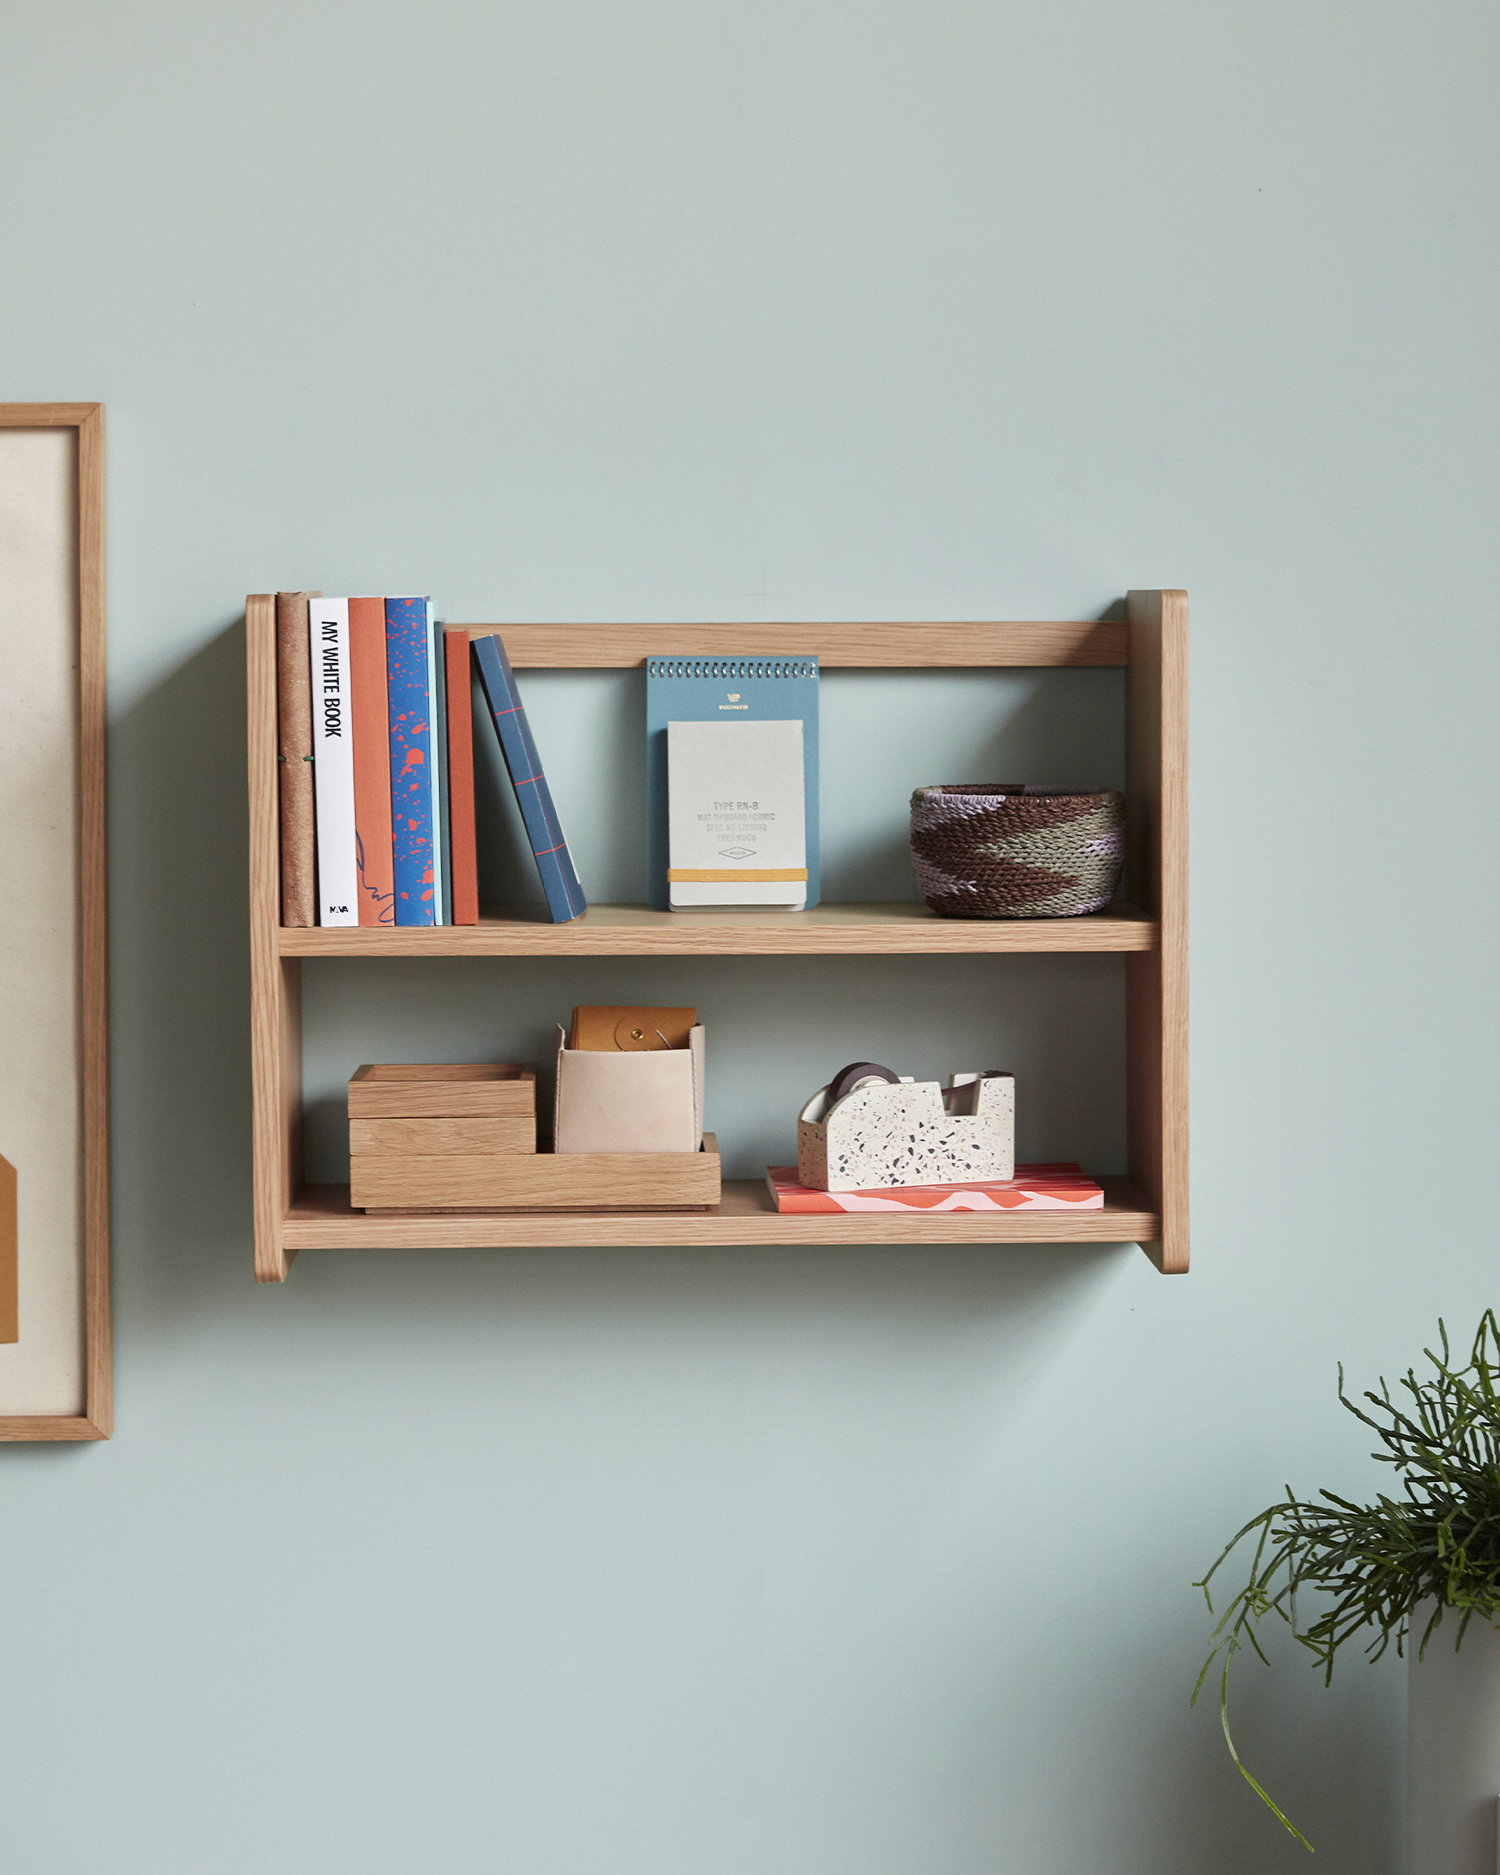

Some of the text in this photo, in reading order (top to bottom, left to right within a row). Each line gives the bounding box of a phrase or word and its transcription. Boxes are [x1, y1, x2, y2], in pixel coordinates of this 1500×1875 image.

[321, 620, 342, 739] MY WHITE BOOK
[713, 801, 759, 811] TYPE RN-B
